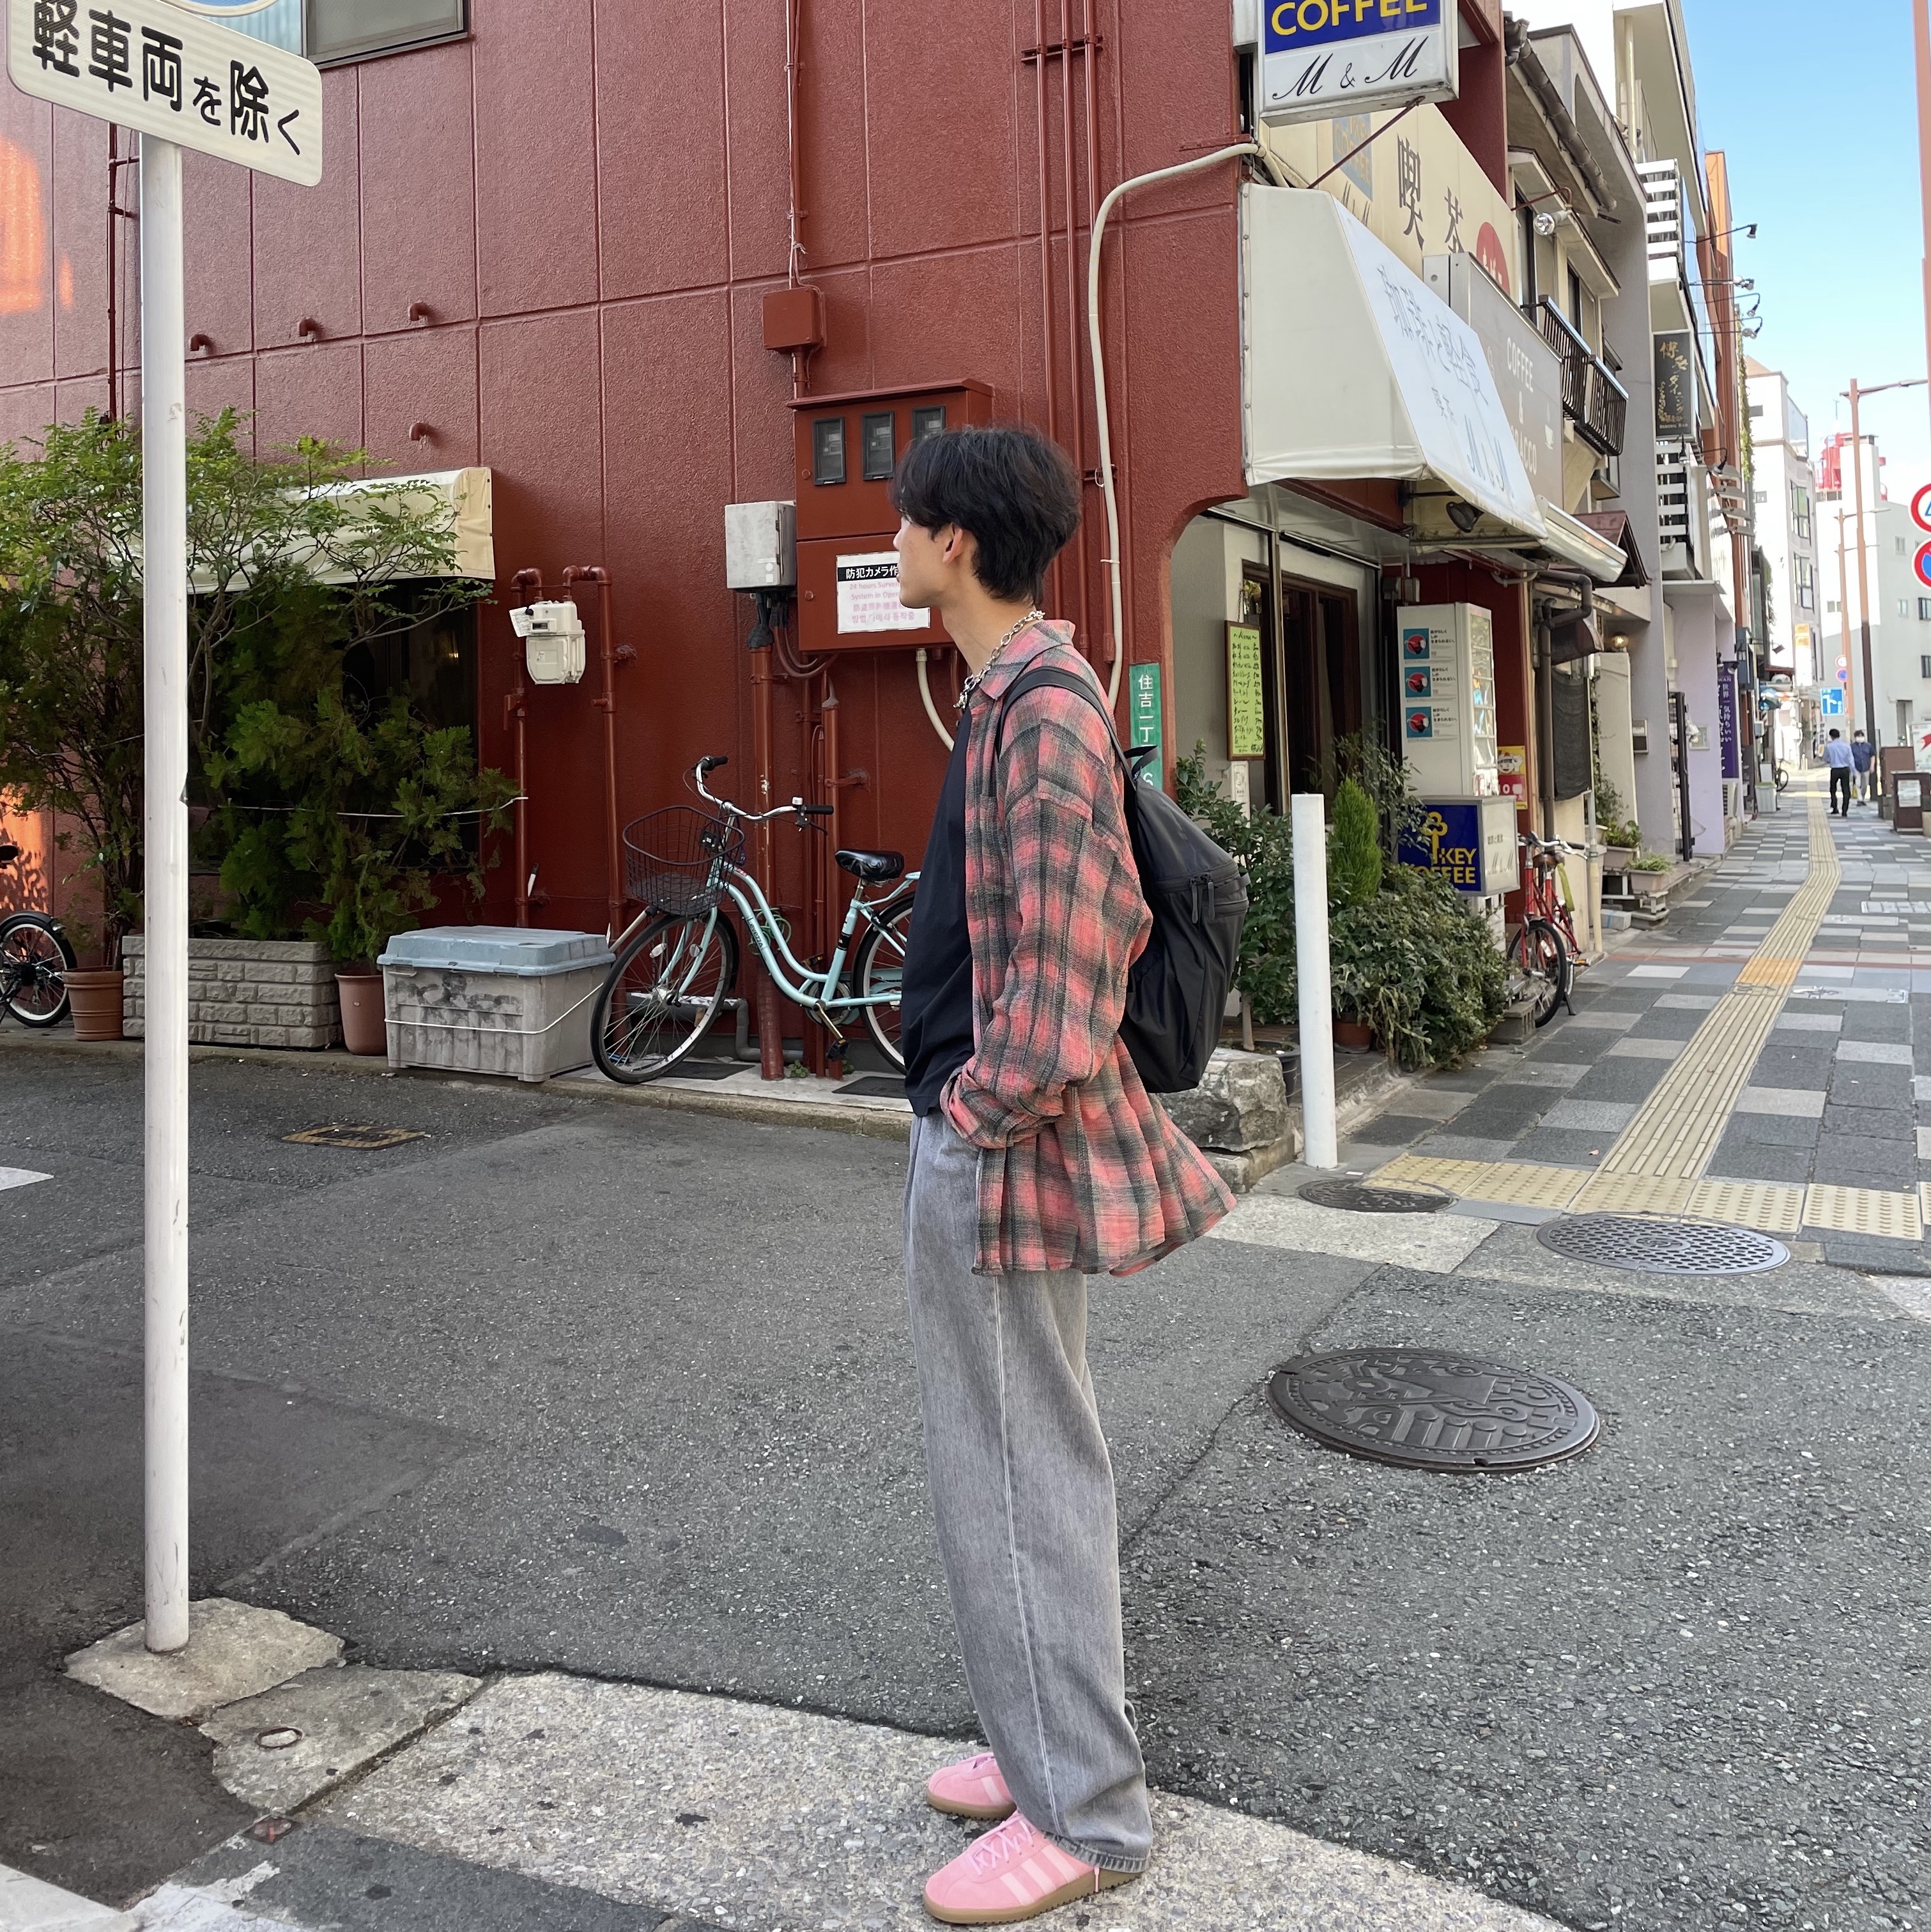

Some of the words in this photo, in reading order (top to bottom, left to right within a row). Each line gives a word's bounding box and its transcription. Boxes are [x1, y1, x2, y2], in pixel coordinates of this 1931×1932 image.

[32, 0, 300, 155] 軽車両を除く
[1272, 53, 1333, 100] M
[1340, 62, 1355, 88] &
[1365, 36, 1429, 83] M
[1397, 133, 1465, 253] 喫茶
[1377, 264, 1488, 406] 珈琲と軽食
[1507, 336, 1534, 393] COFFEE
[1511, 425, 1537, 475] BACCO
[845, 565, 898, 579] 防犯カメラ作
[882, 591, 899, 599] Oper
[1138, 674, 1155, 746] 住吉一丁
[1439, 848, 1477, 864] KEY
